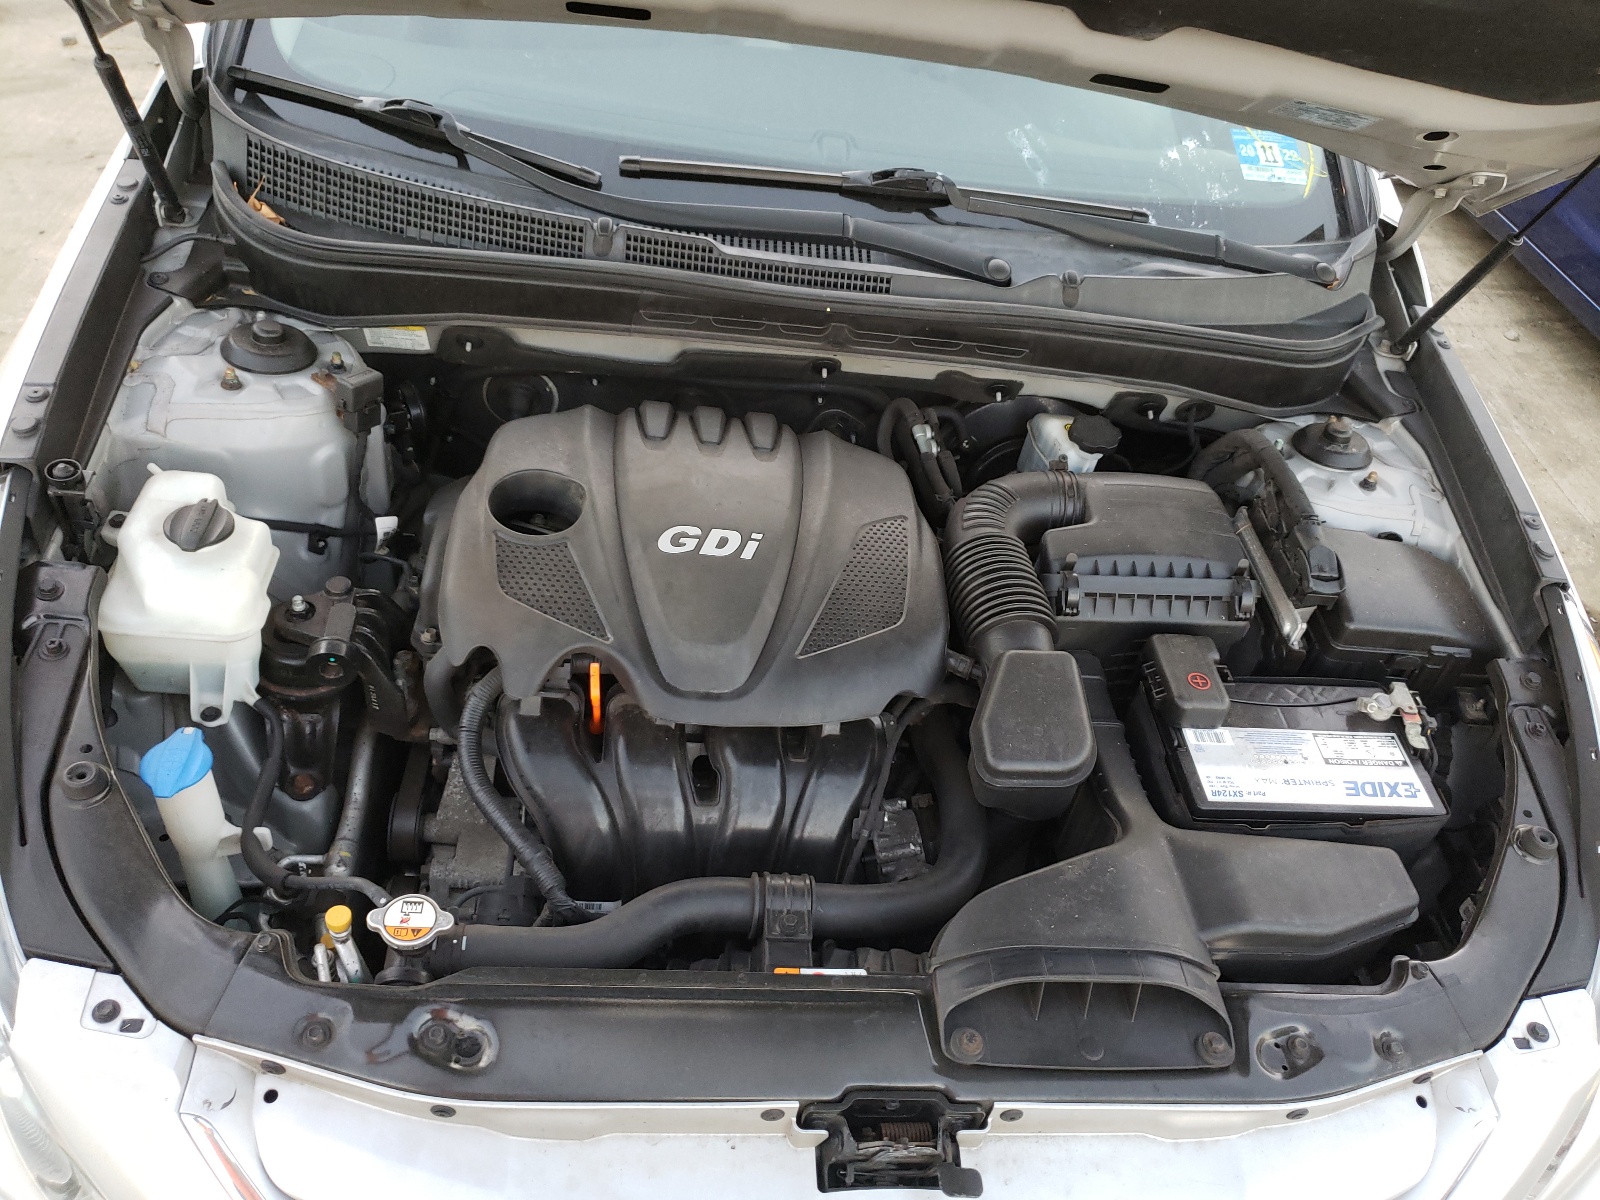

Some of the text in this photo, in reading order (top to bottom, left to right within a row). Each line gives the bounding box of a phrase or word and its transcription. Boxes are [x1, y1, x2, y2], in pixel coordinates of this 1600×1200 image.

[1239, 143, 1256, 157] 20
[1260, 144, 1279, 164] 11
[657, 524, 765, 560] GDi
[1361, 759, 1395, 767] DANGER
[1282, 778, 1336, 787] SPRINTER
[1343, 780, 1421, 799] EXIDE
[1211, 789, 1244, 798] SX124R
